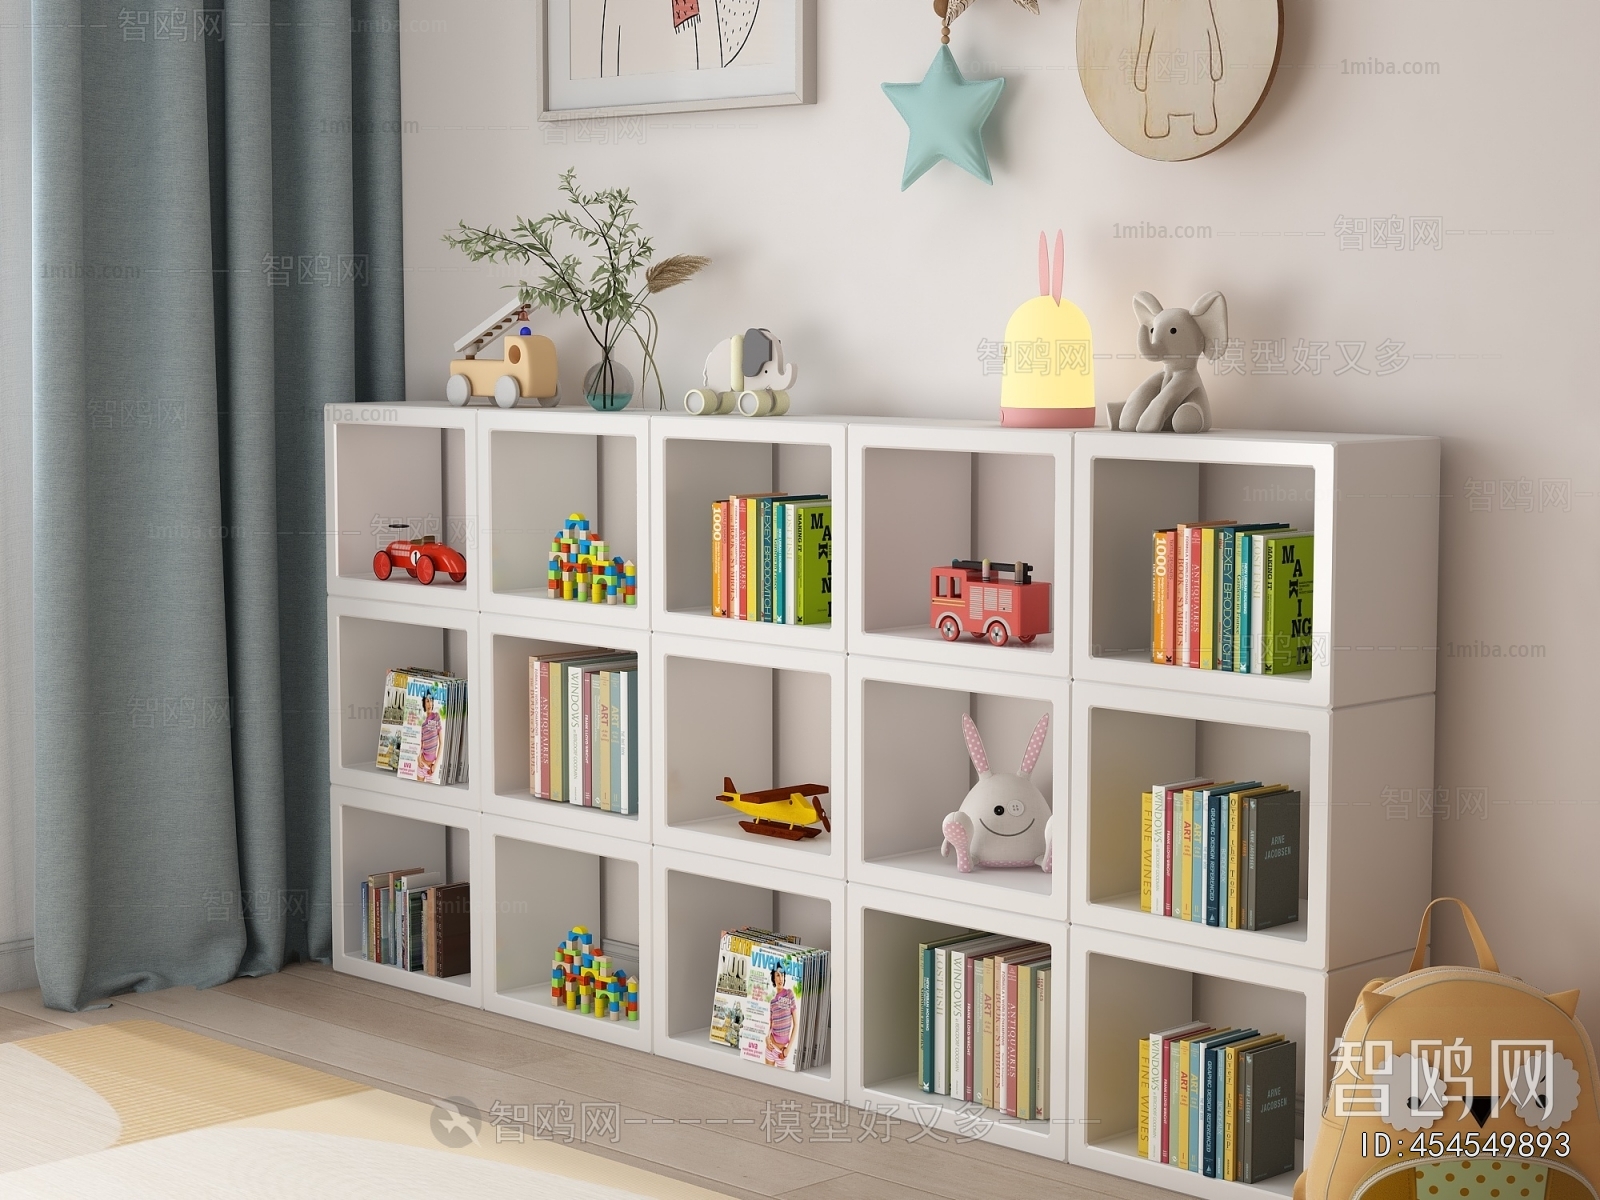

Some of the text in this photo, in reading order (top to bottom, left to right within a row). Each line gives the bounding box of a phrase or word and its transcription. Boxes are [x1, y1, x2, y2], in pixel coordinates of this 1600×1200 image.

[798, 544, 802, 552] IT
[1156, 538, 1166, 576] 1000
[1253, 539, 1261, 599] LOST FISH
[1223, 531, 1233, 662] ALEXEY BRODOVITCH
[1268, 582, 1272, 590] IT
[571, 672, 579, 728] WINDOWS
[601, 704, 609, 726] ART
[611, 706, 619, 728] ART
[1154, 790, 1162, 843] WINDOWS
[1194, 821, 1202, 844] ART
[1271, 835, 1284, 846] ARNE
[1143, 810, 1152, 896] FINE WINES
[1264, 846, 1292, 860] JACOBSEN
[936, 953, 944, 986] LOST
[954, 957, 962, 1017] WINDOWS
[984, 994, 992, 1017] ART
[1151, 1039, 1159, 1090] WINDOWS
[1141, 1056, 1149, 1141] FINE WINES
[1260, 1098, 1287, 1113] JACOBSEN
[1267, 1087, 1281, 1098] ARNE
